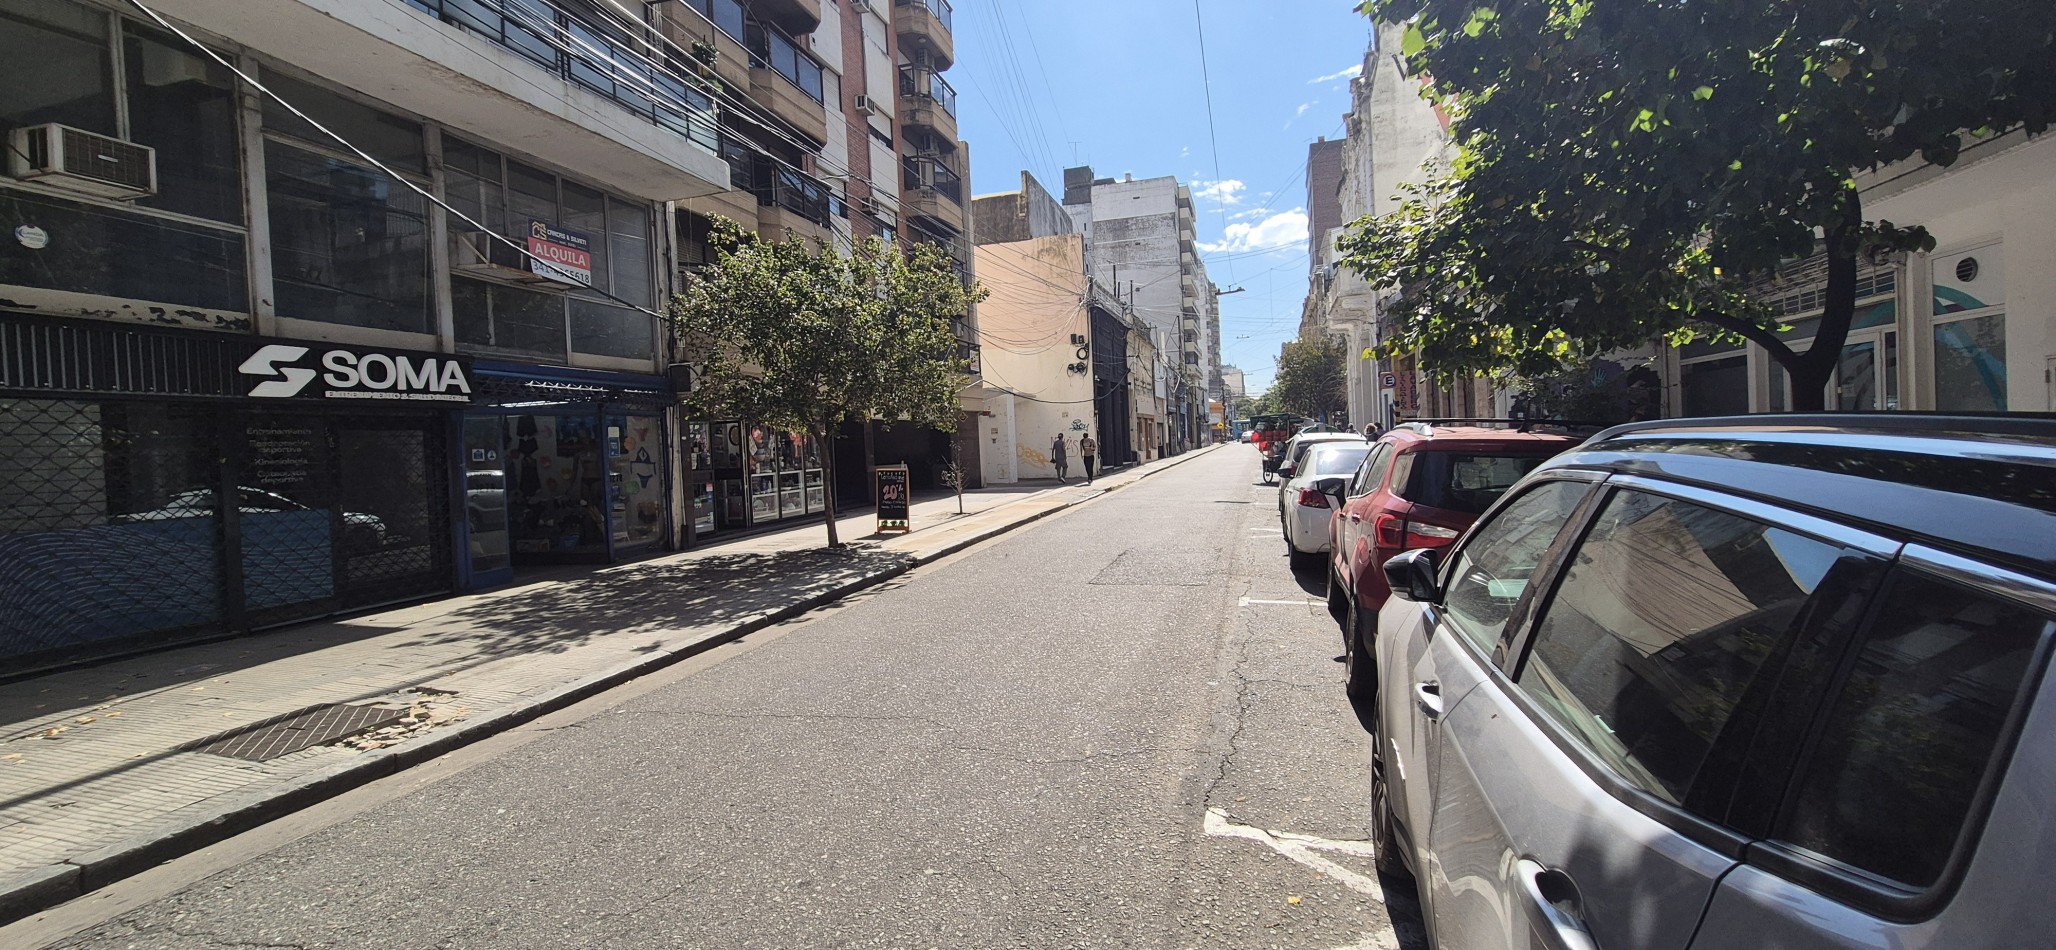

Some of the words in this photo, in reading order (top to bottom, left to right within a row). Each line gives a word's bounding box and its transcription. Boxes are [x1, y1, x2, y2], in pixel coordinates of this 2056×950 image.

[535, 242, 586, 267] ALQUILA
[322, 350, 471, 393] SOMA
[1386, 376, 1393, 384] E
